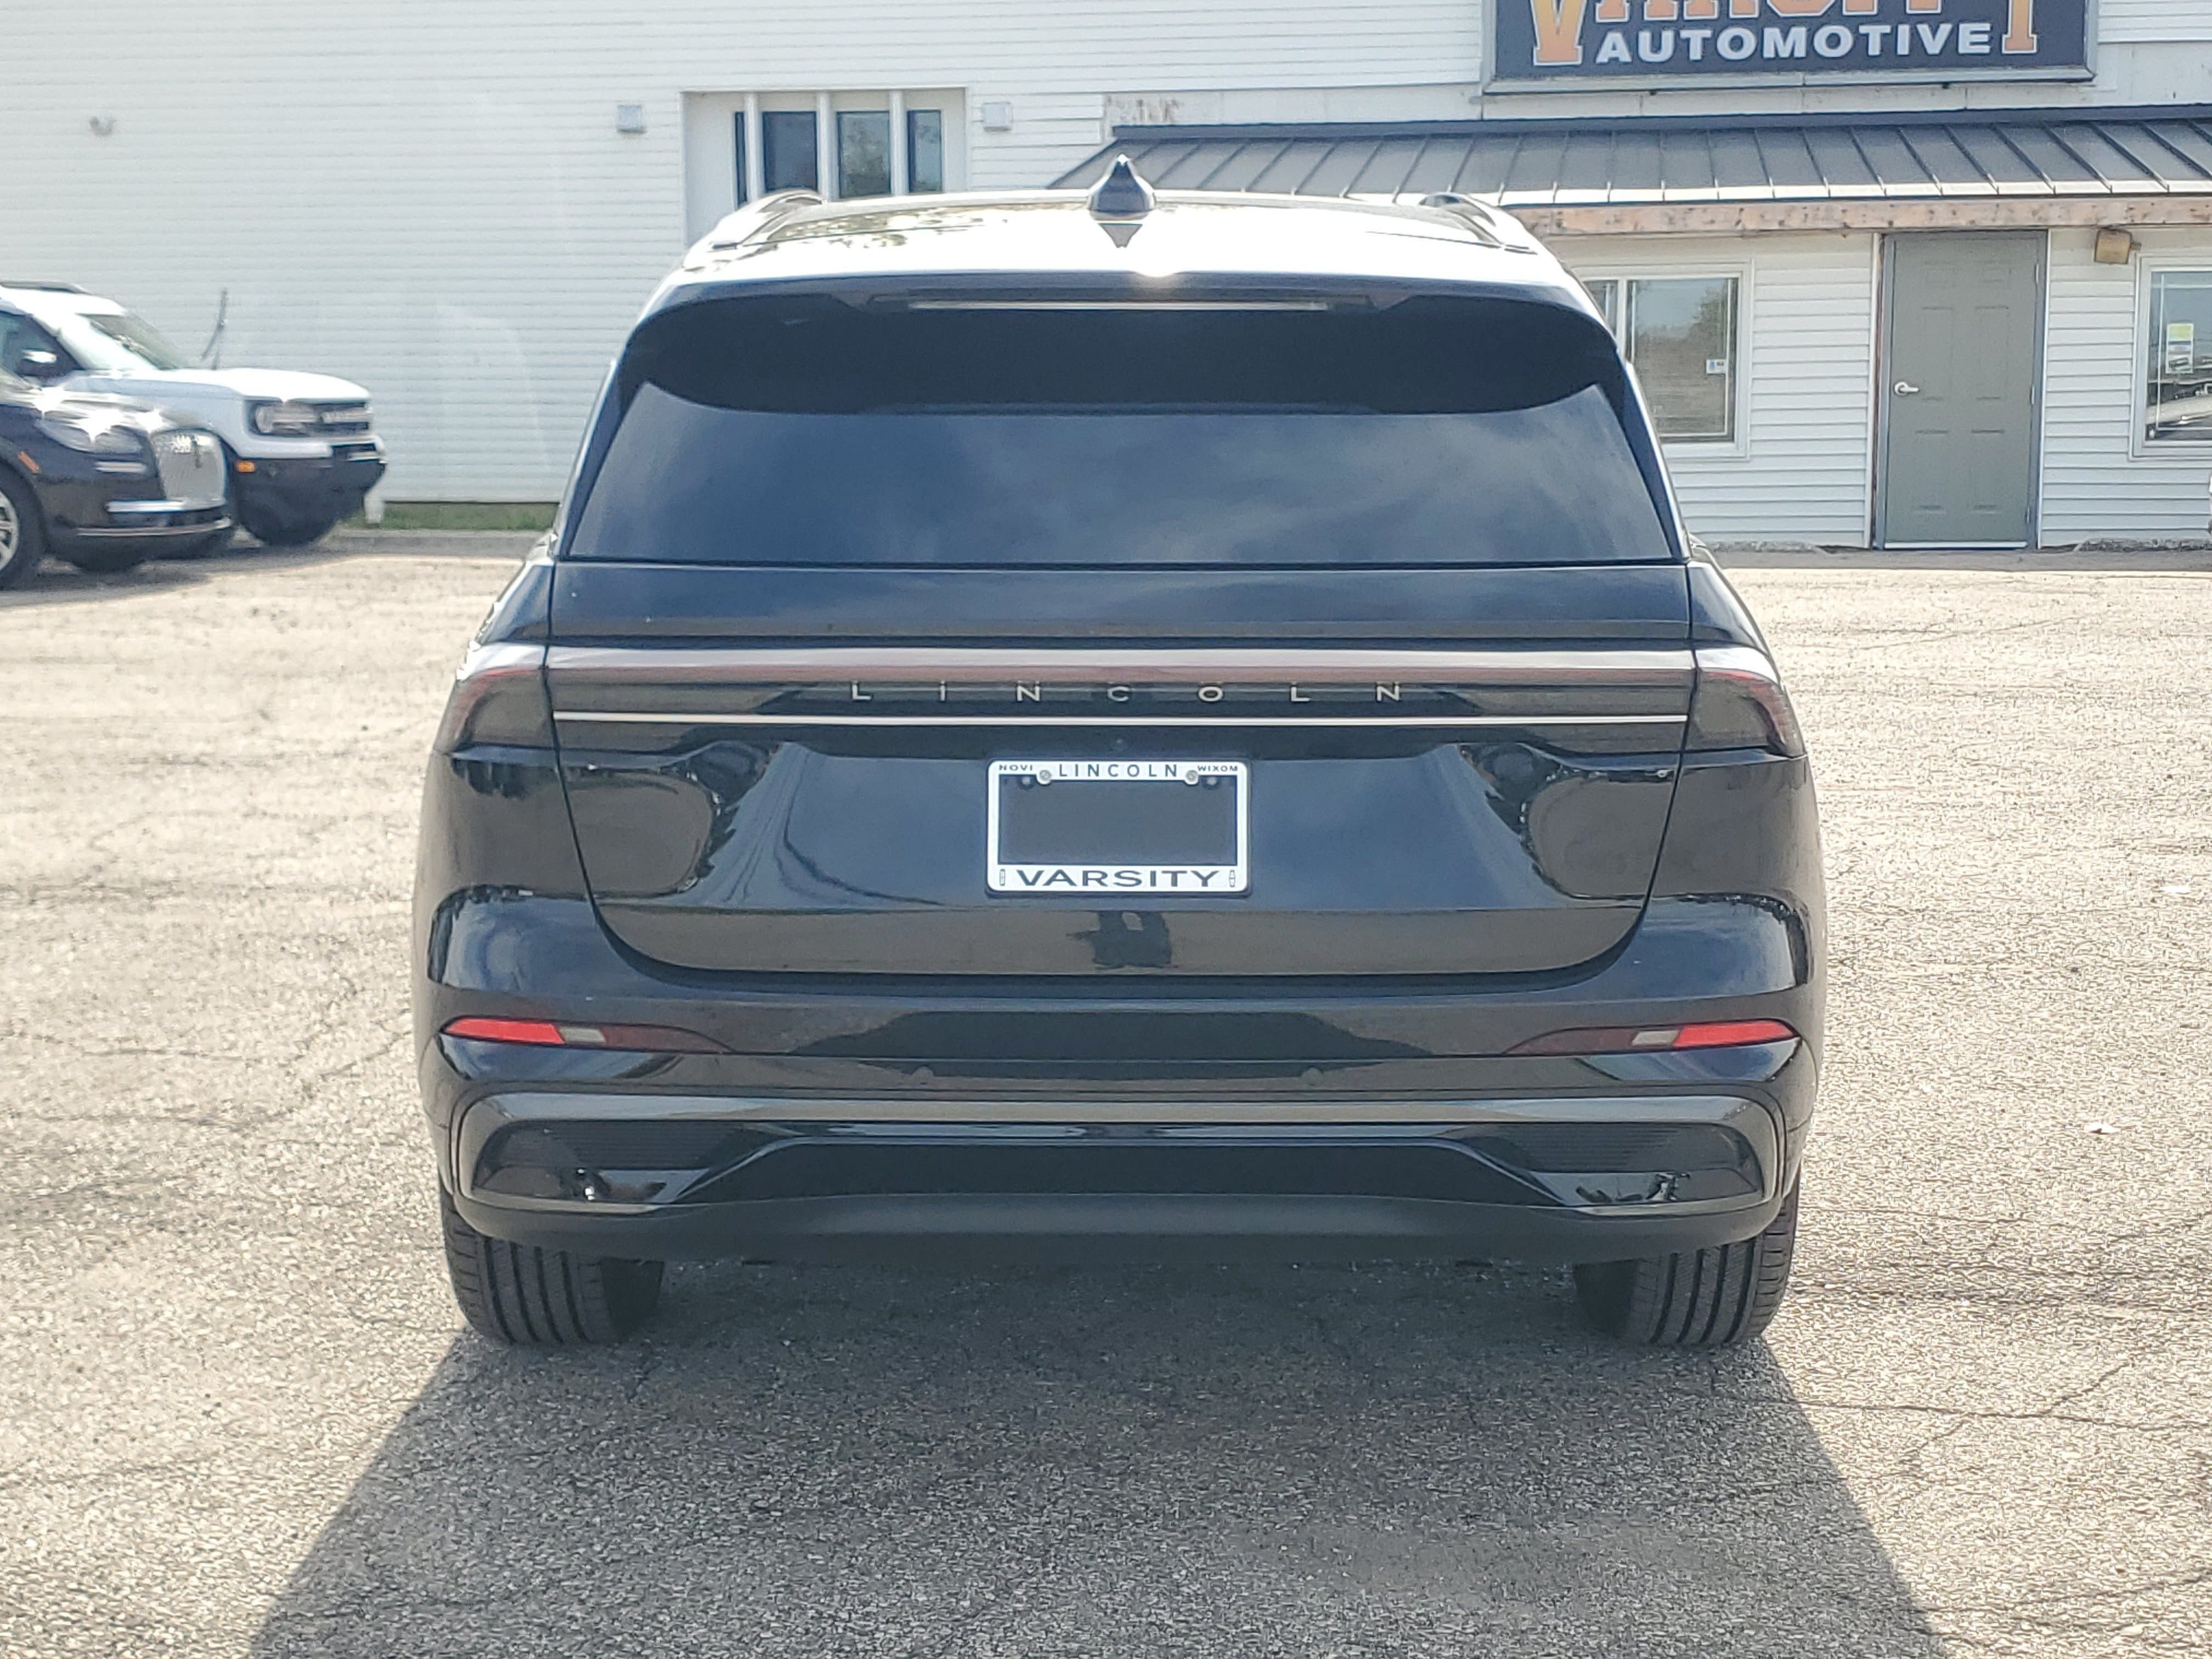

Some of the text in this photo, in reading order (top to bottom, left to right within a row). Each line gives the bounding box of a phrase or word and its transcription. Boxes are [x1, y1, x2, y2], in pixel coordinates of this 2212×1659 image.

[1596, 23, 1991, 64] AUTOMOTIVE
[851, 684, 1401, 702] LINCOLN
[1059, 764, 1177, 777] LINCOLN
[1017, 869, 1220, 887] VARSITY
